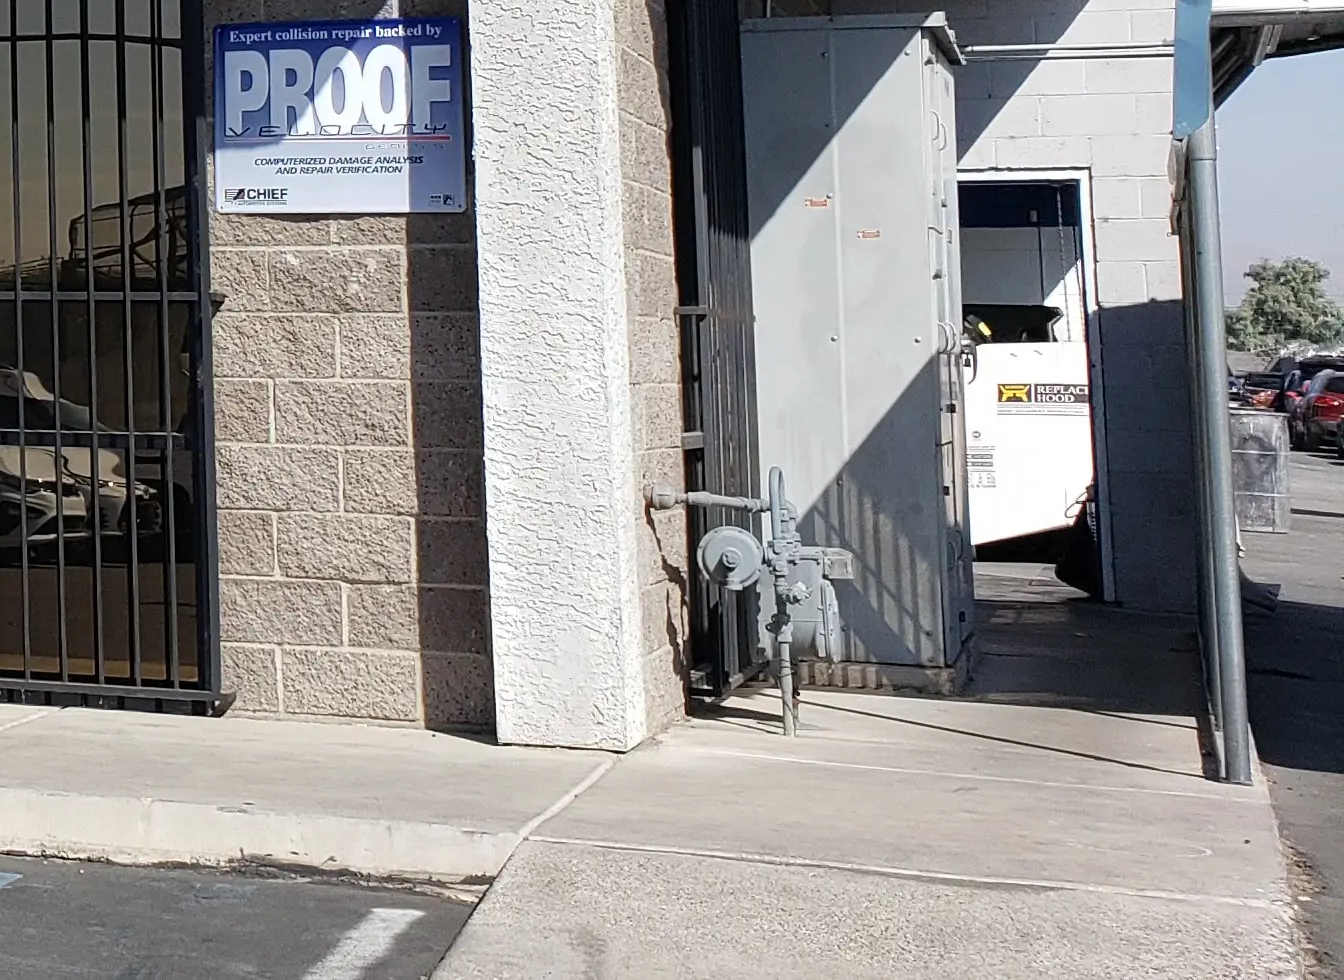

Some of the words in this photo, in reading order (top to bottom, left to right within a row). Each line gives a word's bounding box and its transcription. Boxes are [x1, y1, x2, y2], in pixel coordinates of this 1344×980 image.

[229, 30, 272, 45] Expert
[275, 27, 328, 41] collision
[331, 26, 371, 42] repair
[375, 23, 421, 38] backed
[426, 23, 443, 39] by
[224, 44, 451, 137] PROOF
[228, 122, 447, 138] VELOCITY
[254, 156, 326, 167] COMPUTERIZED
[329, 156, 373, 166] DAMAGE
[375, 155, 424, 165] ANALYSIS
[275, 166, 298, 175] AND
[299, 166, 333, 175] REPAIR
[336, 165, 403, 174] VERIFICATION
[246, 188, 288, 200] CHIEF
[1036, 393, 1075, 403] HOOD
